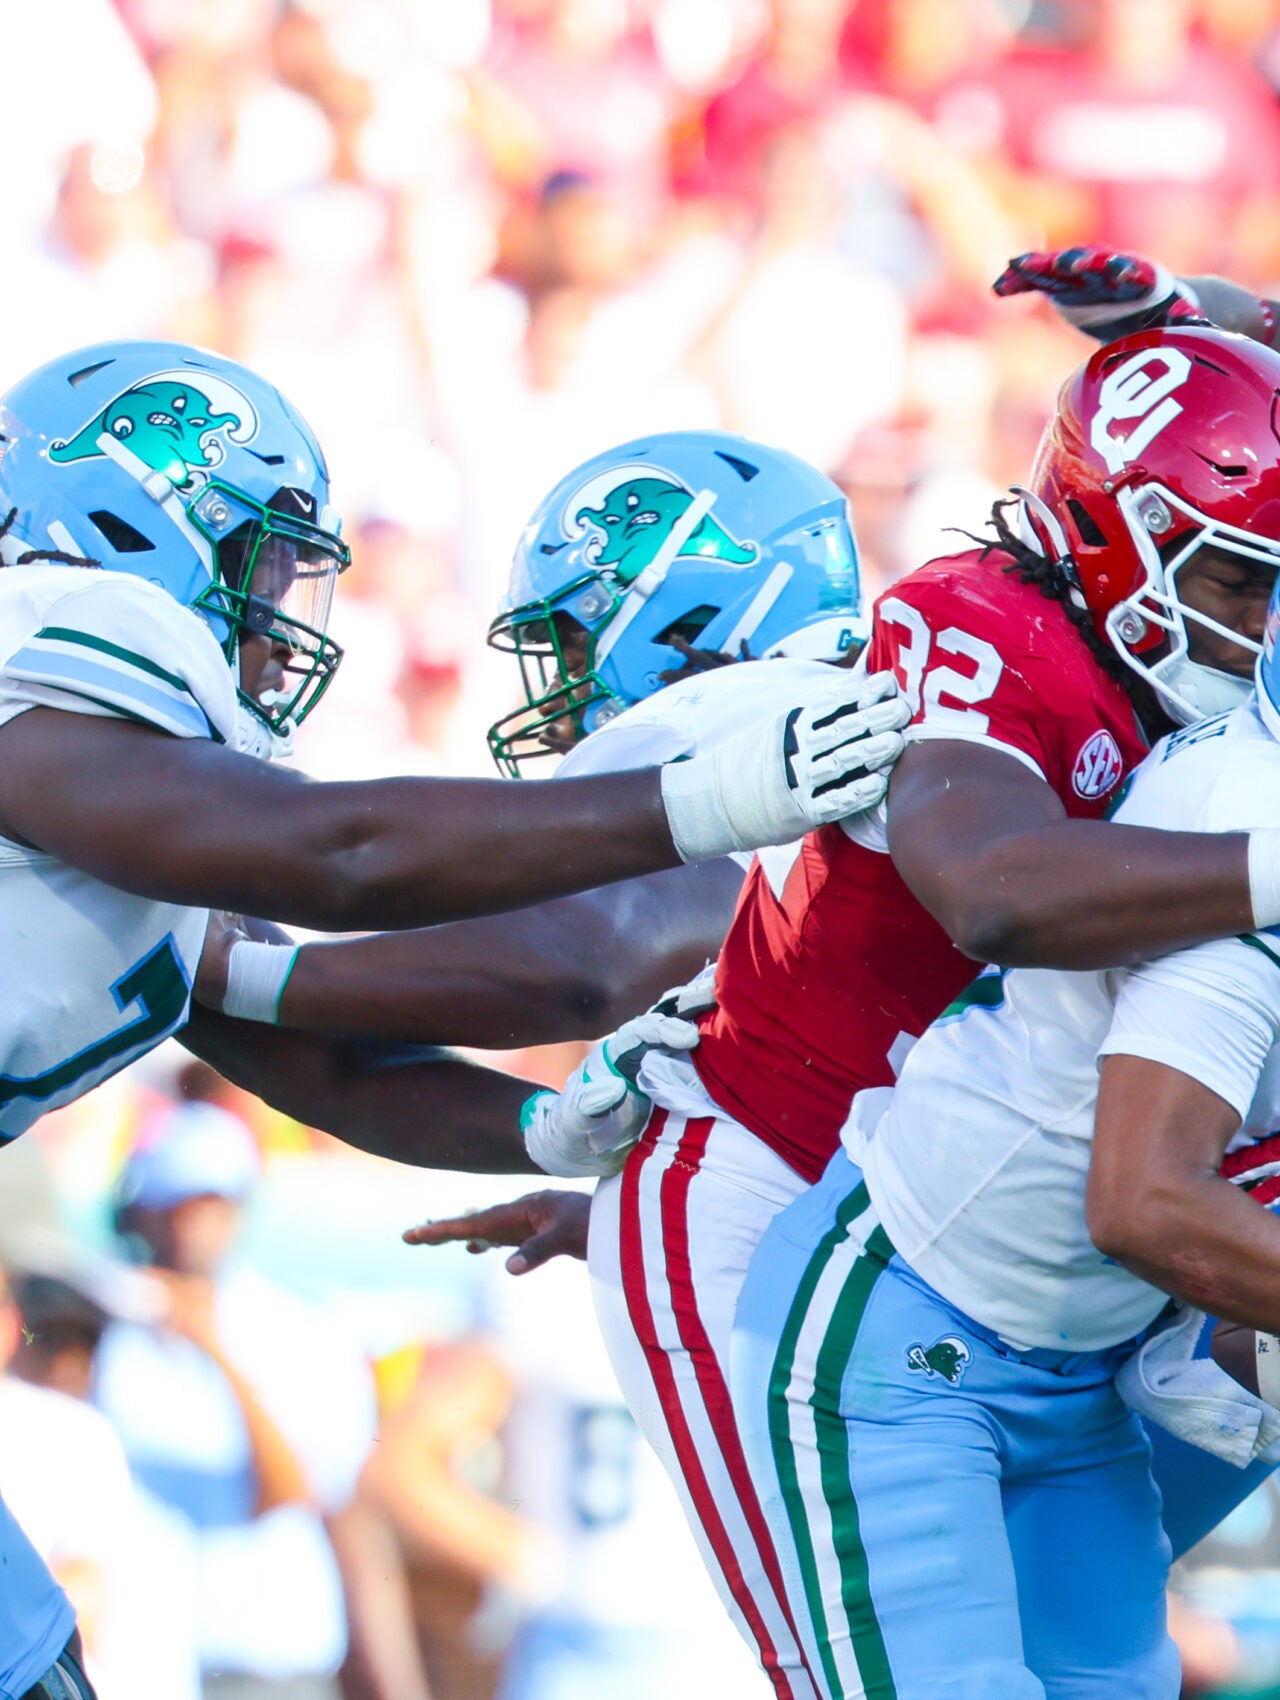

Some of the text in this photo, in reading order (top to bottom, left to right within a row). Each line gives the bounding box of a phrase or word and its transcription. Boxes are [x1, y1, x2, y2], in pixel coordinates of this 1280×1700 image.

[1091, 347, 1192, 475] OU
[879, 597, 1004, 735] 32
[1075, 734, 1117, 795] SEC
